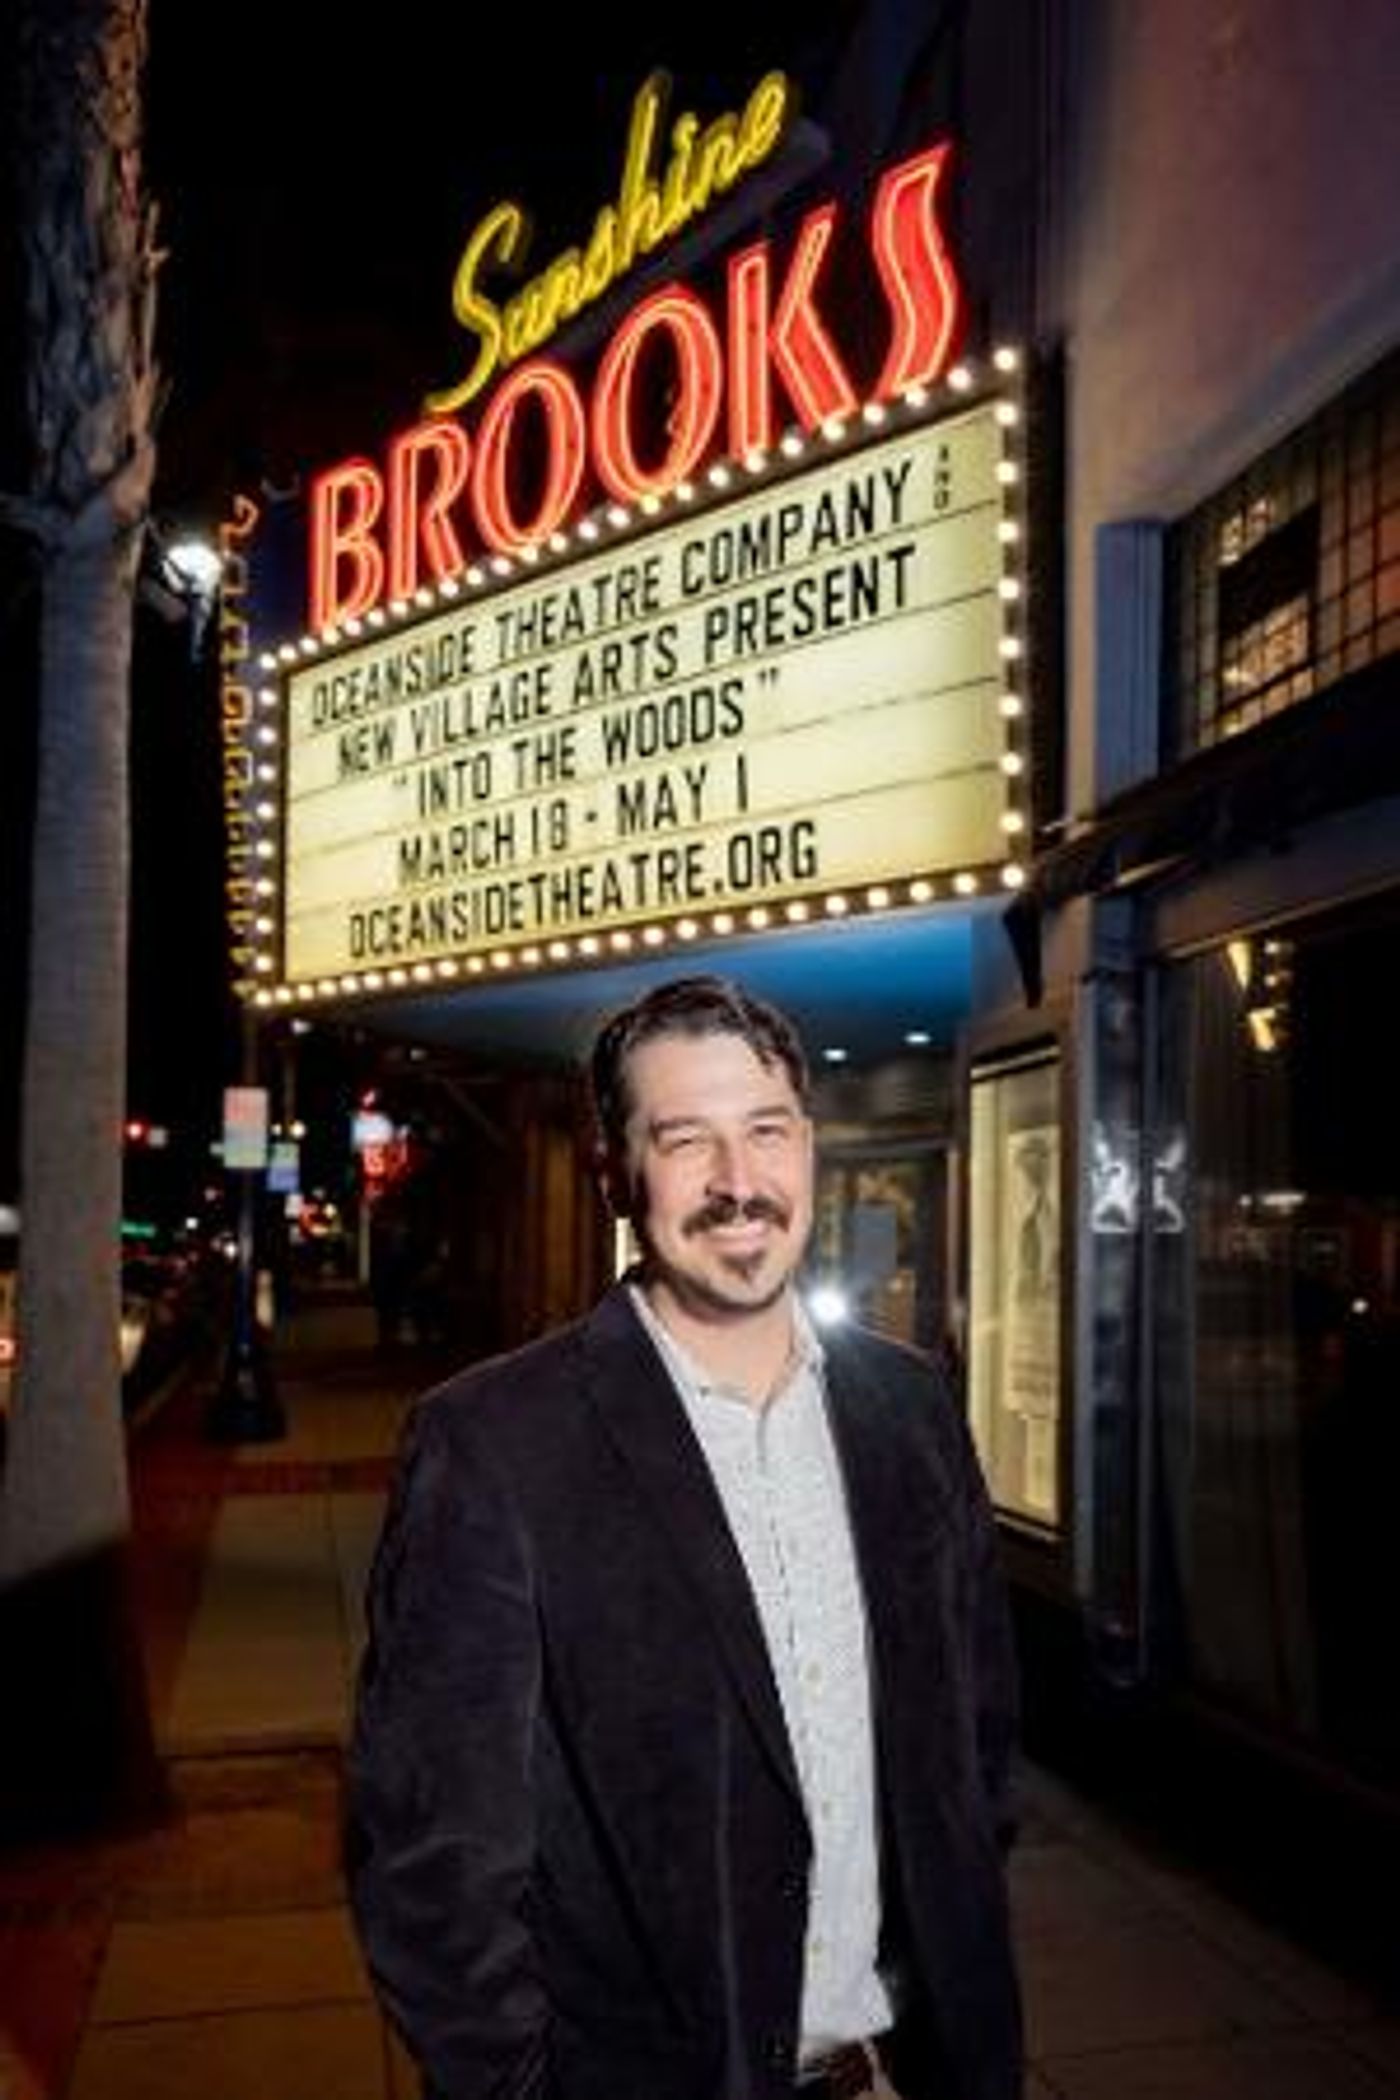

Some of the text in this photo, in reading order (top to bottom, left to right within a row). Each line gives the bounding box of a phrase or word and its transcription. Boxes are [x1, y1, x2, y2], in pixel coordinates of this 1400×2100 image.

[425, 70, 788, 413] Sunshine
[309, 138, 963, 634] BROOKS
[312, 460, 912, 726] OCEANSIDE THEATRE COMPANY
[339, 543, 916, 776] NEW VILLAGE ARTS PRESENT
[400, 813, 515, 886] MARCH
[531, 798, 567, 855] 18
[617, 764, 707, 837] MAY
[512, 727, 576, 790] THE
[351, 821, 818, 957] OCEANSIDETHEATRE.ORG
